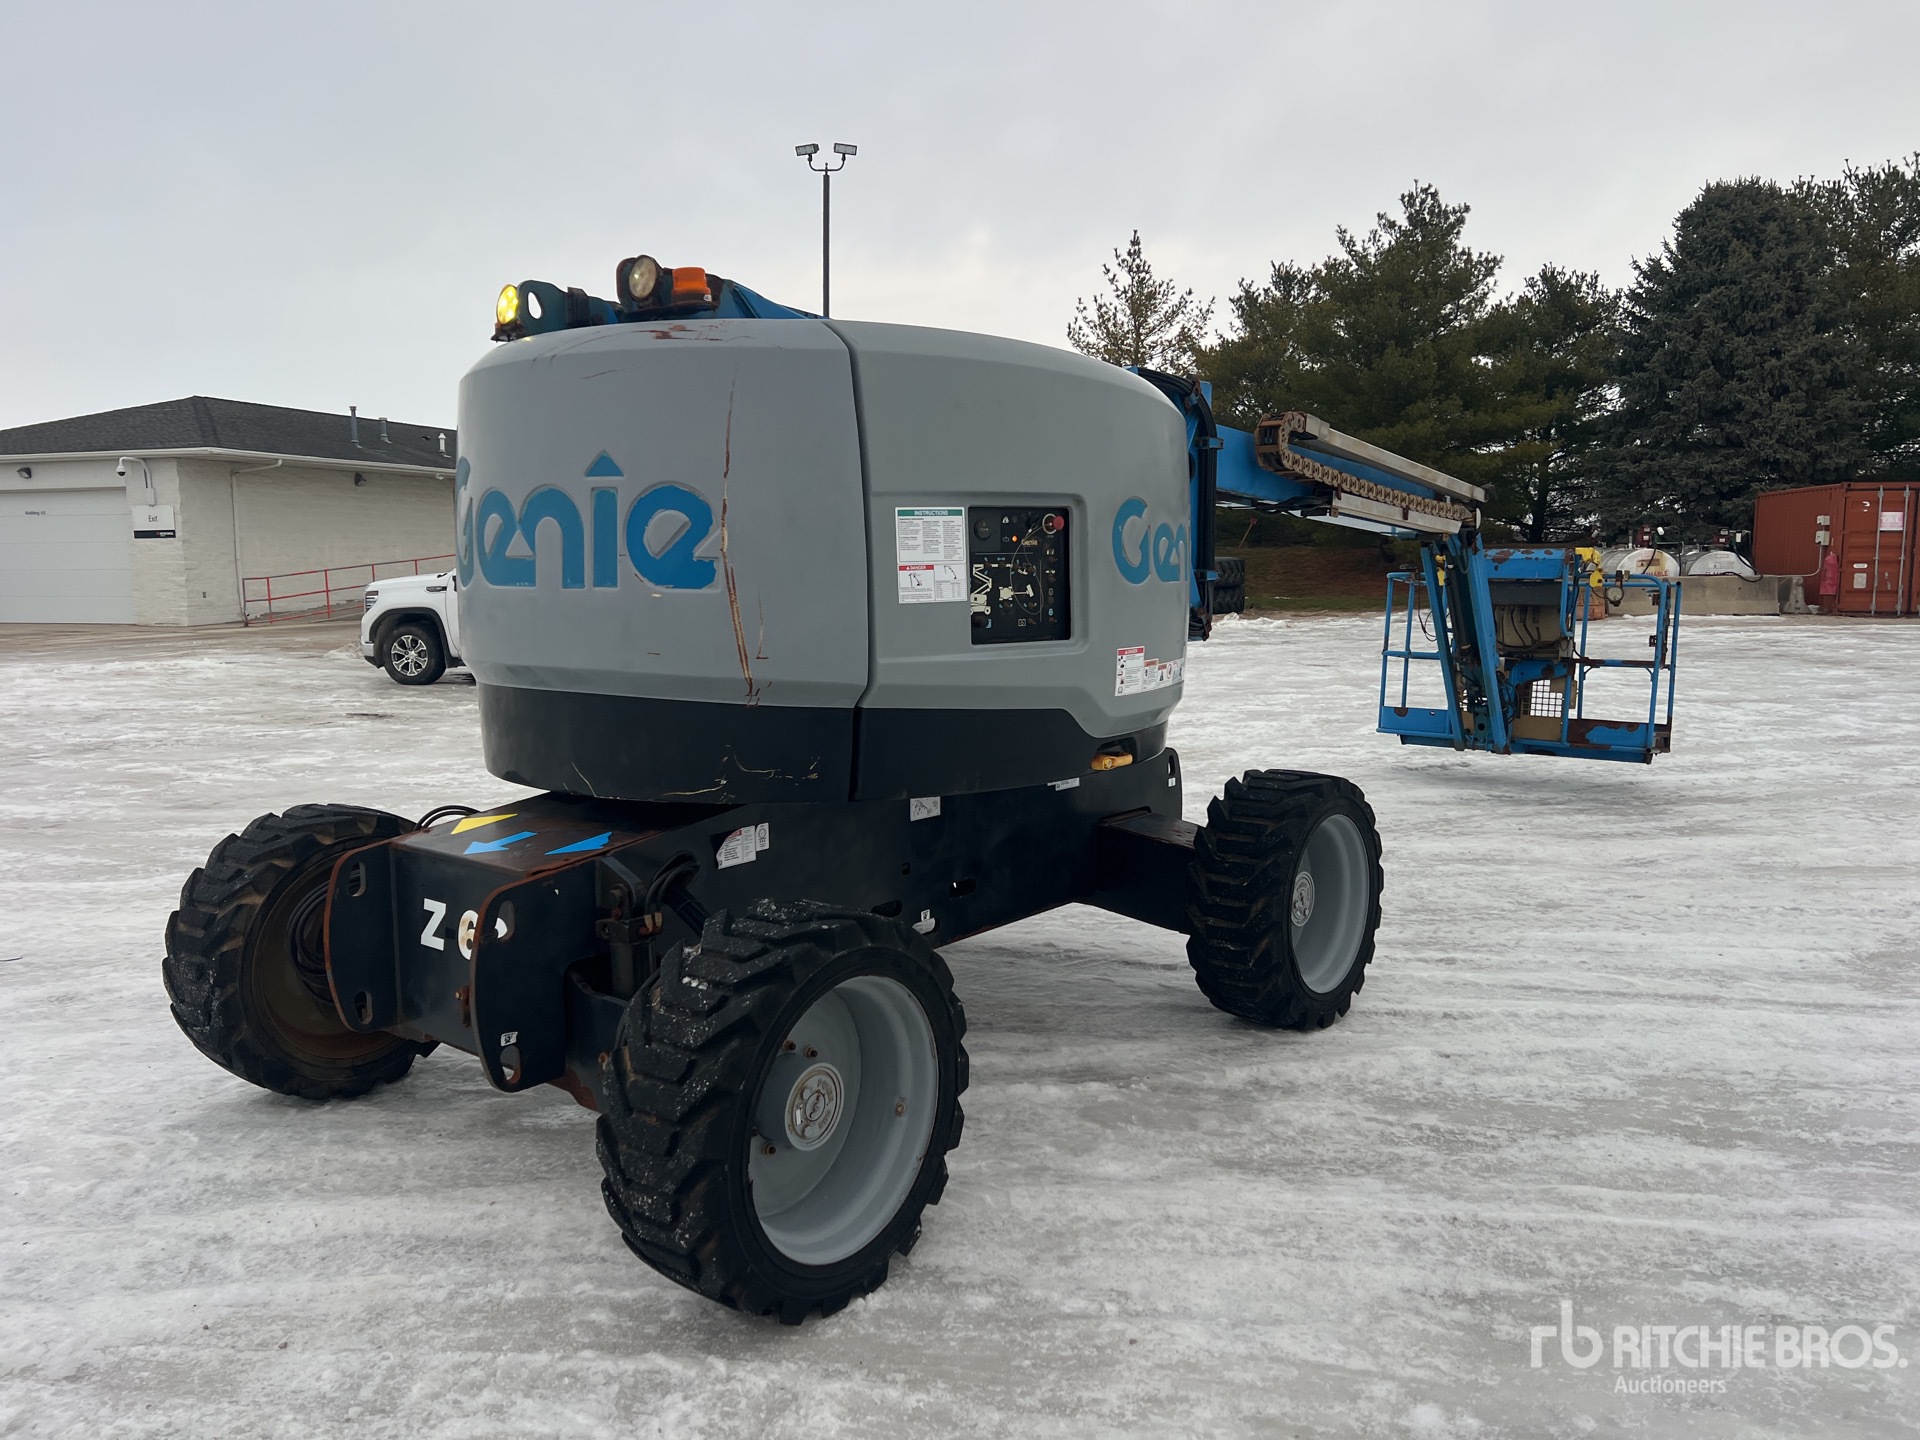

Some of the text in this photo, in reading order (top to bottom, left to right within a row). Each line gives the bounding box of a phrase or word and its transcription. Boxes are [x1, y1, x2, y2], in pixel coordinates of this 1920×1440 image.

[148, 514, 158, 522] Exit
[1112, 496, 1188, 585] Gen
[420, 898, 447, 951] Z
